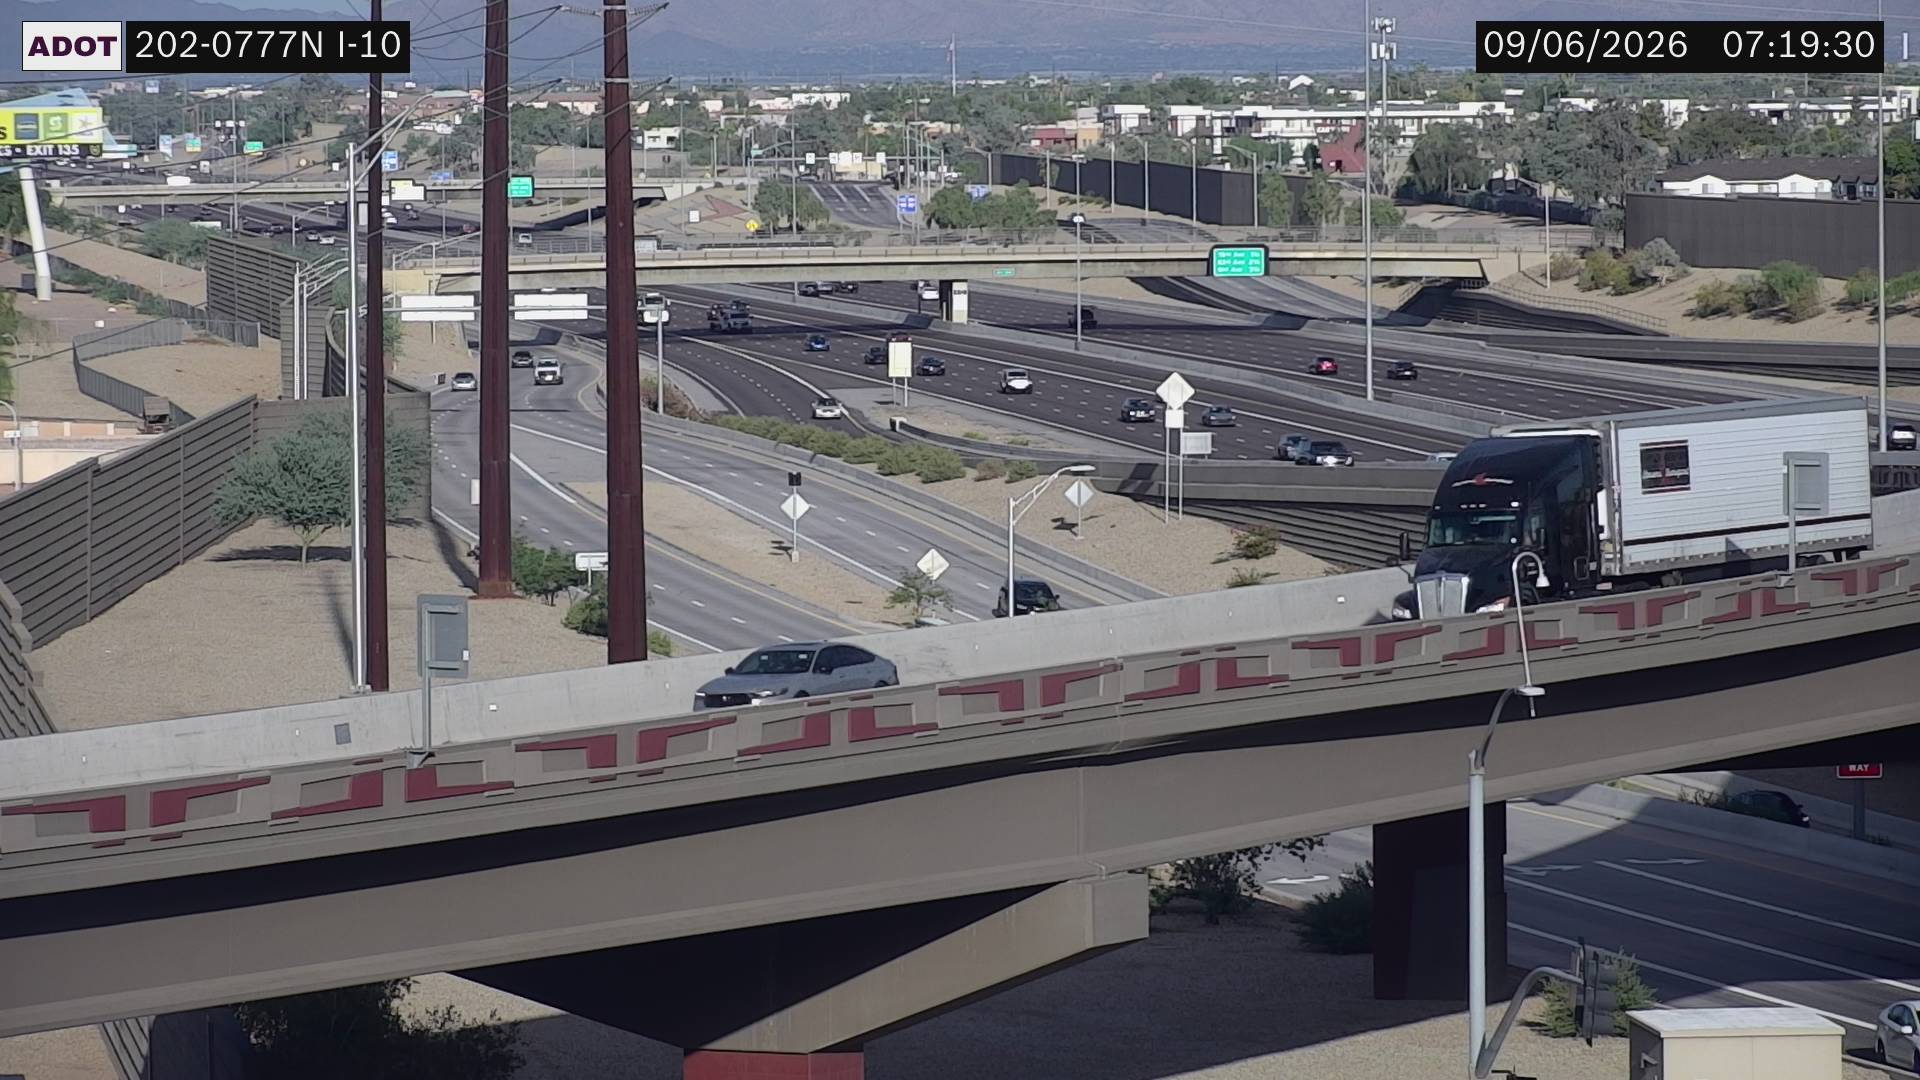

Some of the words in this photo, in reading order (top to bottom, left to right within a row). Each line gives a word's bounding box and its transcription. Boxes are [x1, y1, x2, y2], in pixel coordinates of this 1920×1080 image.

[26, 144, 54, 156] EXIT
[57, 144, 80, 155] 135
[1848, 764, 1870, 772] WAY
